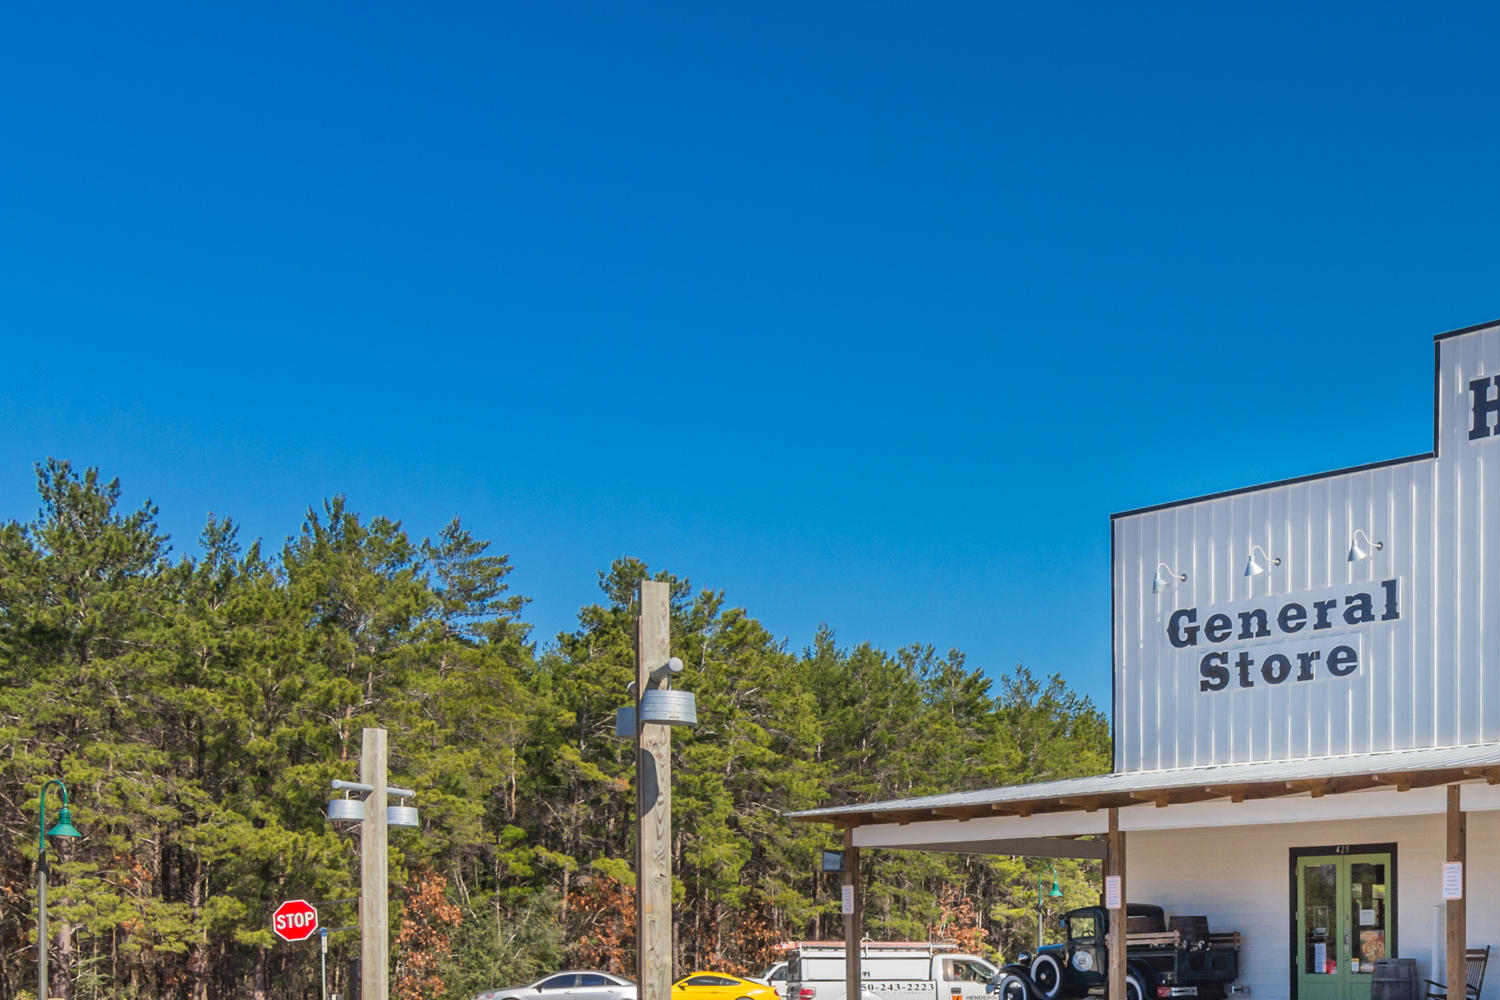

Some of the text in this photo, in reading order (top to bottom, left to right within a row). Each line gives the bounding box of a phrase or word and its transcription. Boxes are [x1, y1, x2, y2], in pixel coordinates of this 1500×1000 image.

[1167, 579, 1400, 648] General
[1200, 645, 1358, 692] Store
[1336, 845, 1350, 854] 425
[276, 911, 315, 930] STOP
